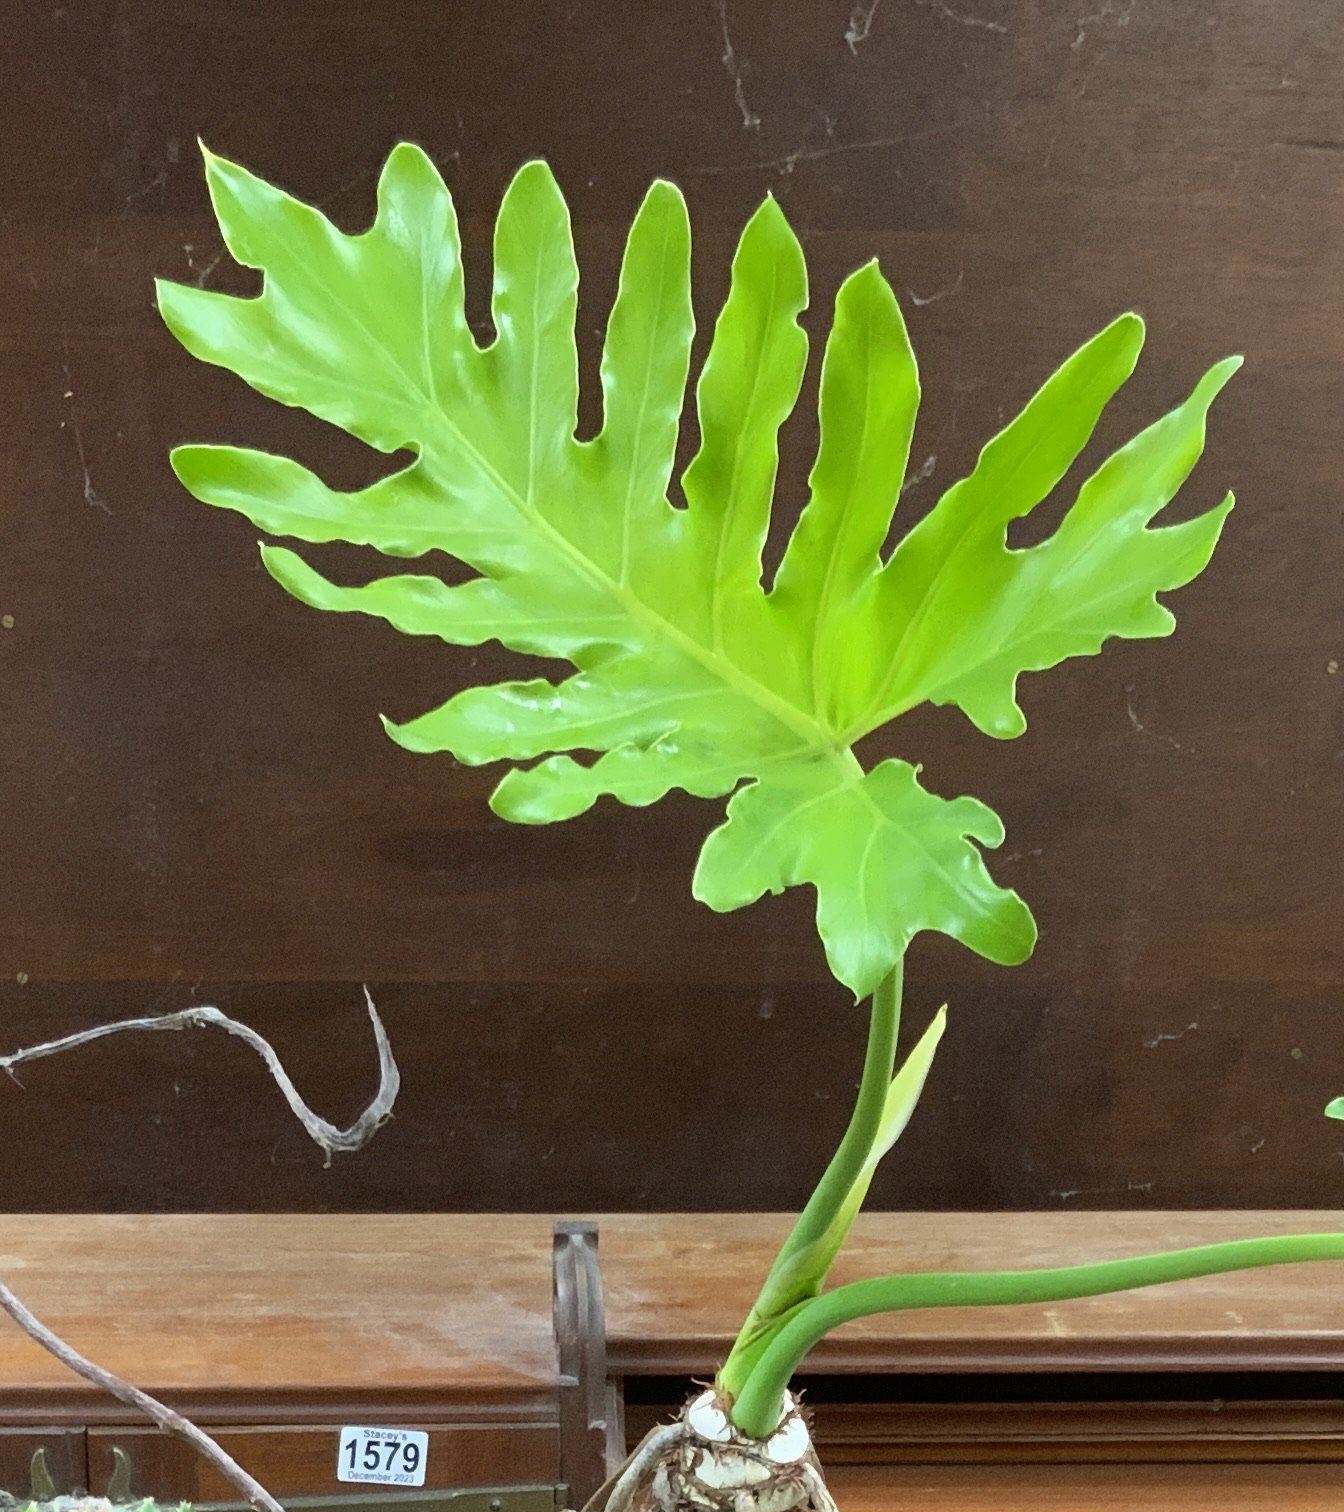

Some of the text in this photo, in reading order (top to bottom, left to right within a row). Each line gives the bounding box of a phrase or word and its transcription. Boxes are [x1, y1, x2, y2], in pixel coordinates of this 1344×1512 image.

[363, 1429, 408, 1442] Stacey's
[345, 1439, 420, 1473] 1579
[348, 1470, 414, 1483] December 2023
